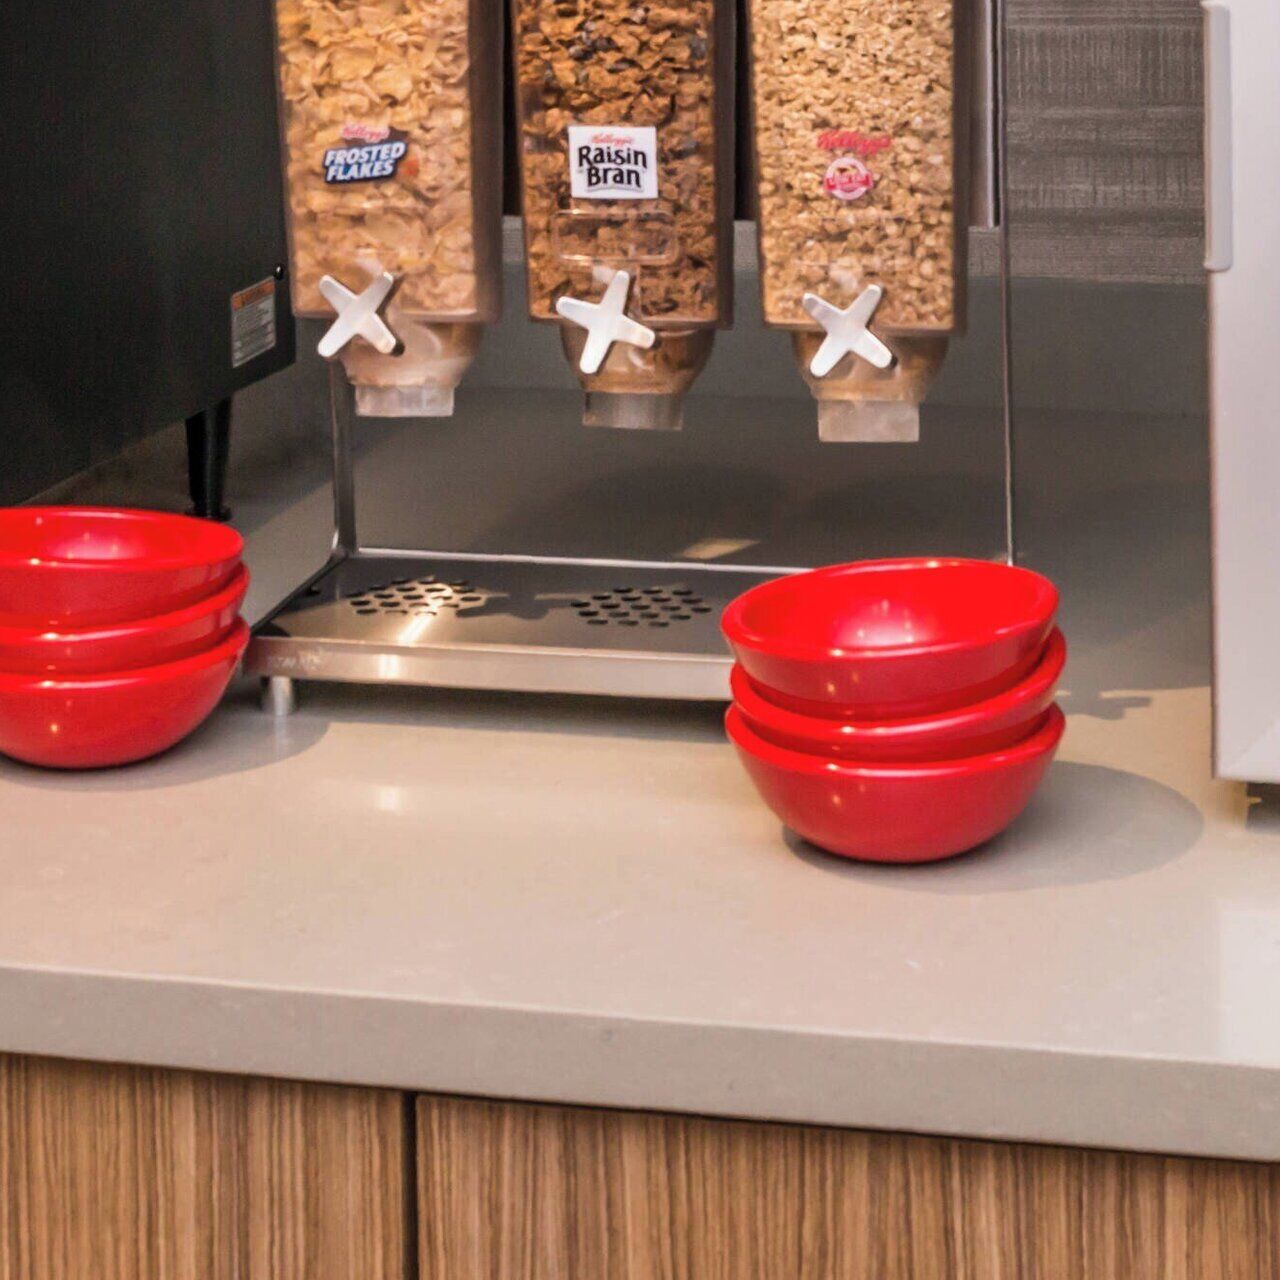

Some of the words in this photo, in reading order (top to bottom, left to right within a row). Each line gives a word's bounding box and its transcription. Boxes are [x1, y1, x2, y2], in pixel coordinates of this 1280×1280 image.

[324, 141, 407, 166] FROSTED
[578, 145, 647, 169] Raisin
[326, 160, 395, 181] FLAKES
[587, 166, 642, 188] Bran
